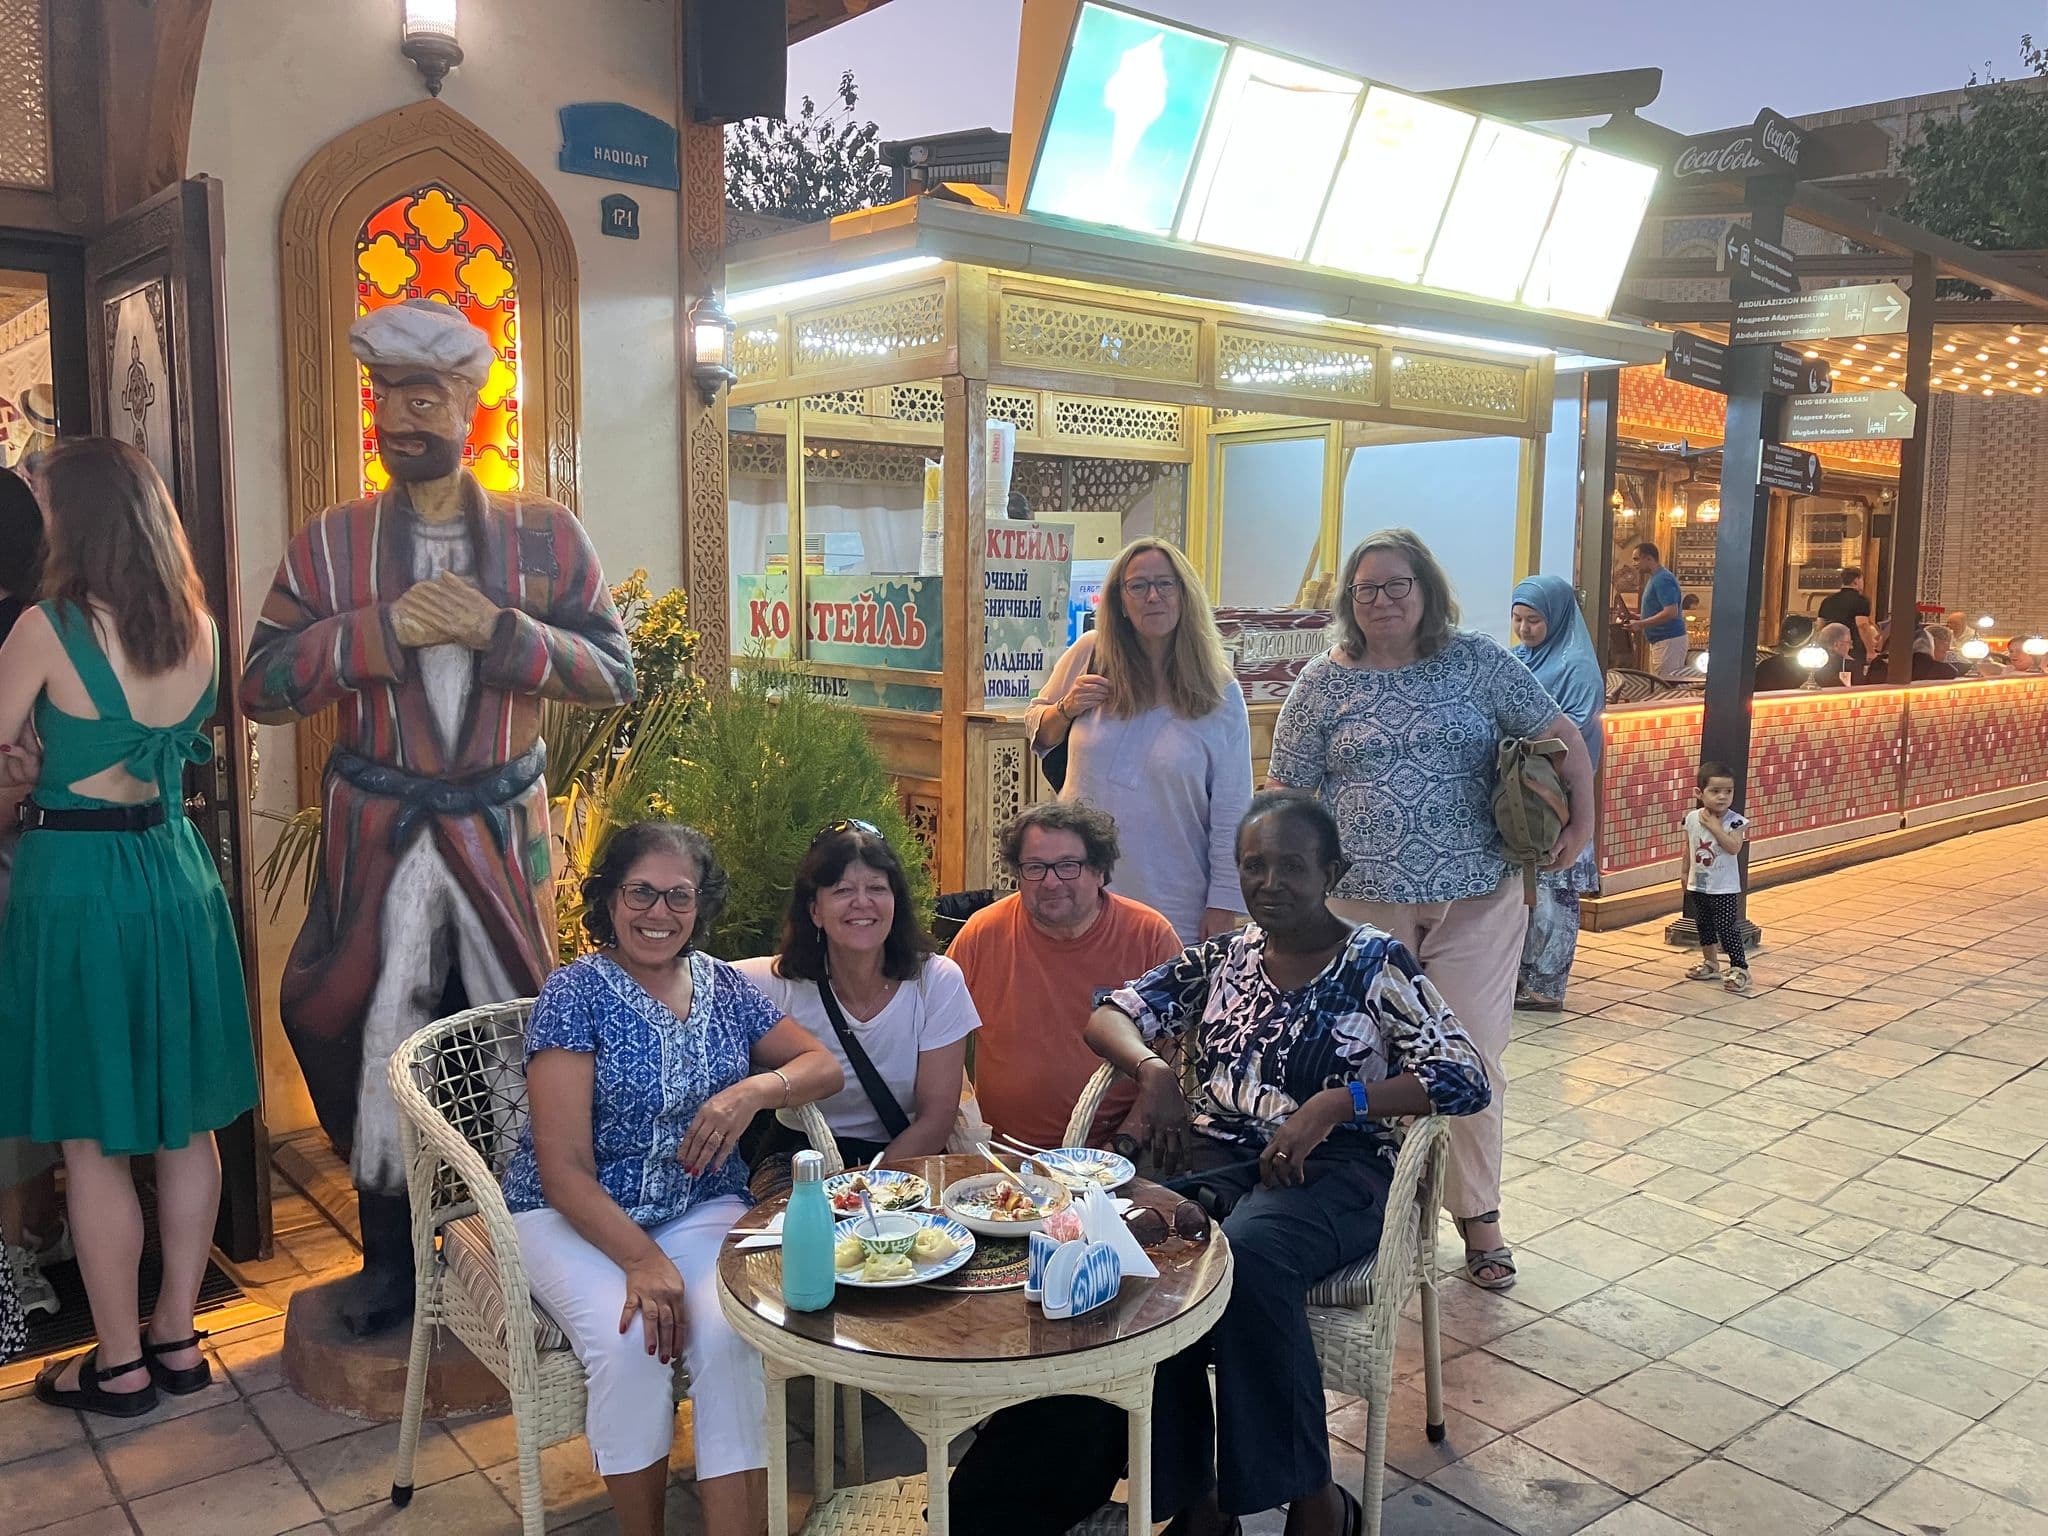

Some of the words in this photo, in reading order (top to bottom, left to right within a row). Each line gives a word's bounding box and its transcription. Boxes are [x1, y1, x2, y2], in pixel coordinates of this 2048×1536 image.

[594, 147, 648, 168] HAQIQAT
[612, 209, 632, 227] 171
[986, 524, 1069, 562] КТЕЙЛЬ
[984, 568, 1028, 591] ОЧНЫЙ
[985, 596, 1042, 618] НИЧНЫЙ
[1288, 633, 1325, 655] 10.000
[984, 648, 1043, 673] ОЛАДНЫЙ
[984, 674, 1030, 697] НОВЫЙ
